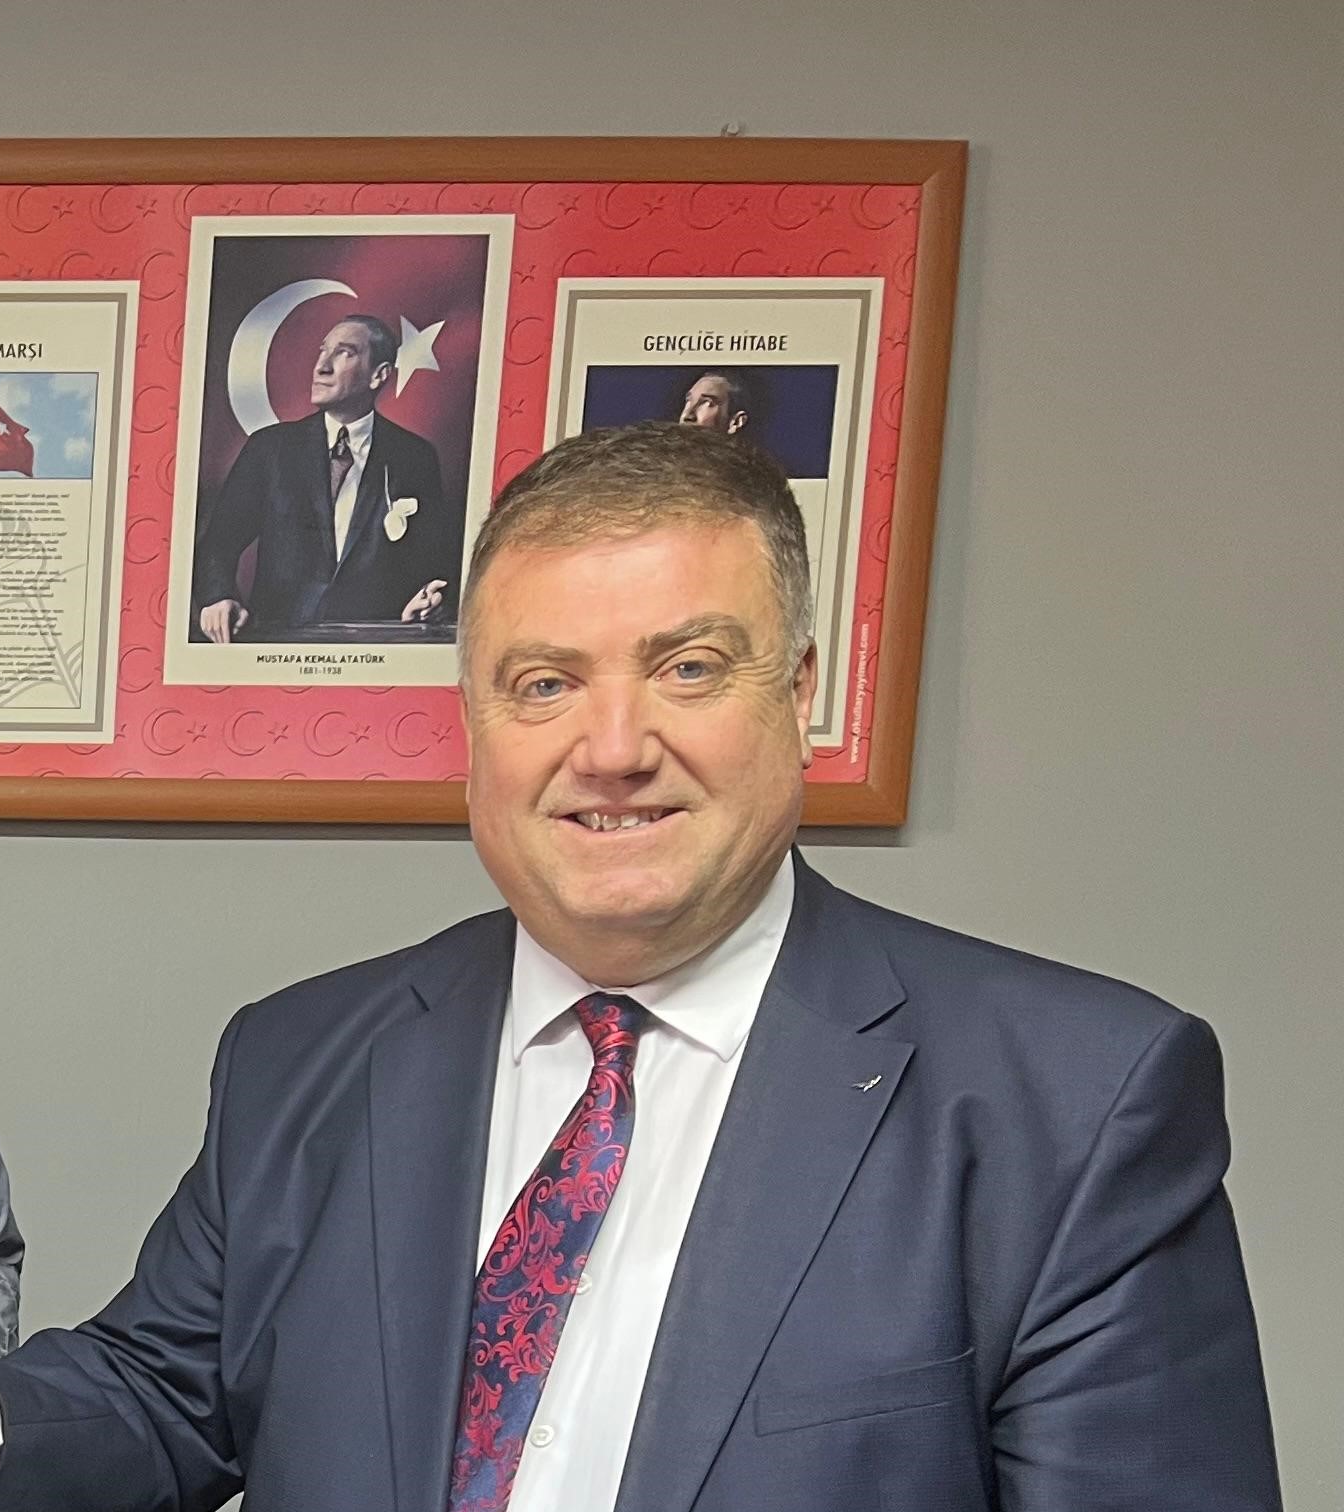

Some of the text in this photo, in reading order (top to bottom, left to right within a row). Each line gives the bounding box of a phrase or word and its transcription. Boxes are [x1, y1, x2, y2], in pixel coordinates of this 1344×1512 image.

[643, 329, 789, 356] GENÇLİĞE HİTABE
[256, 652, 386, 664] MUSTAFA KEMAL ATATÜRK
[298, 666, 343, 675] 1881-1938
